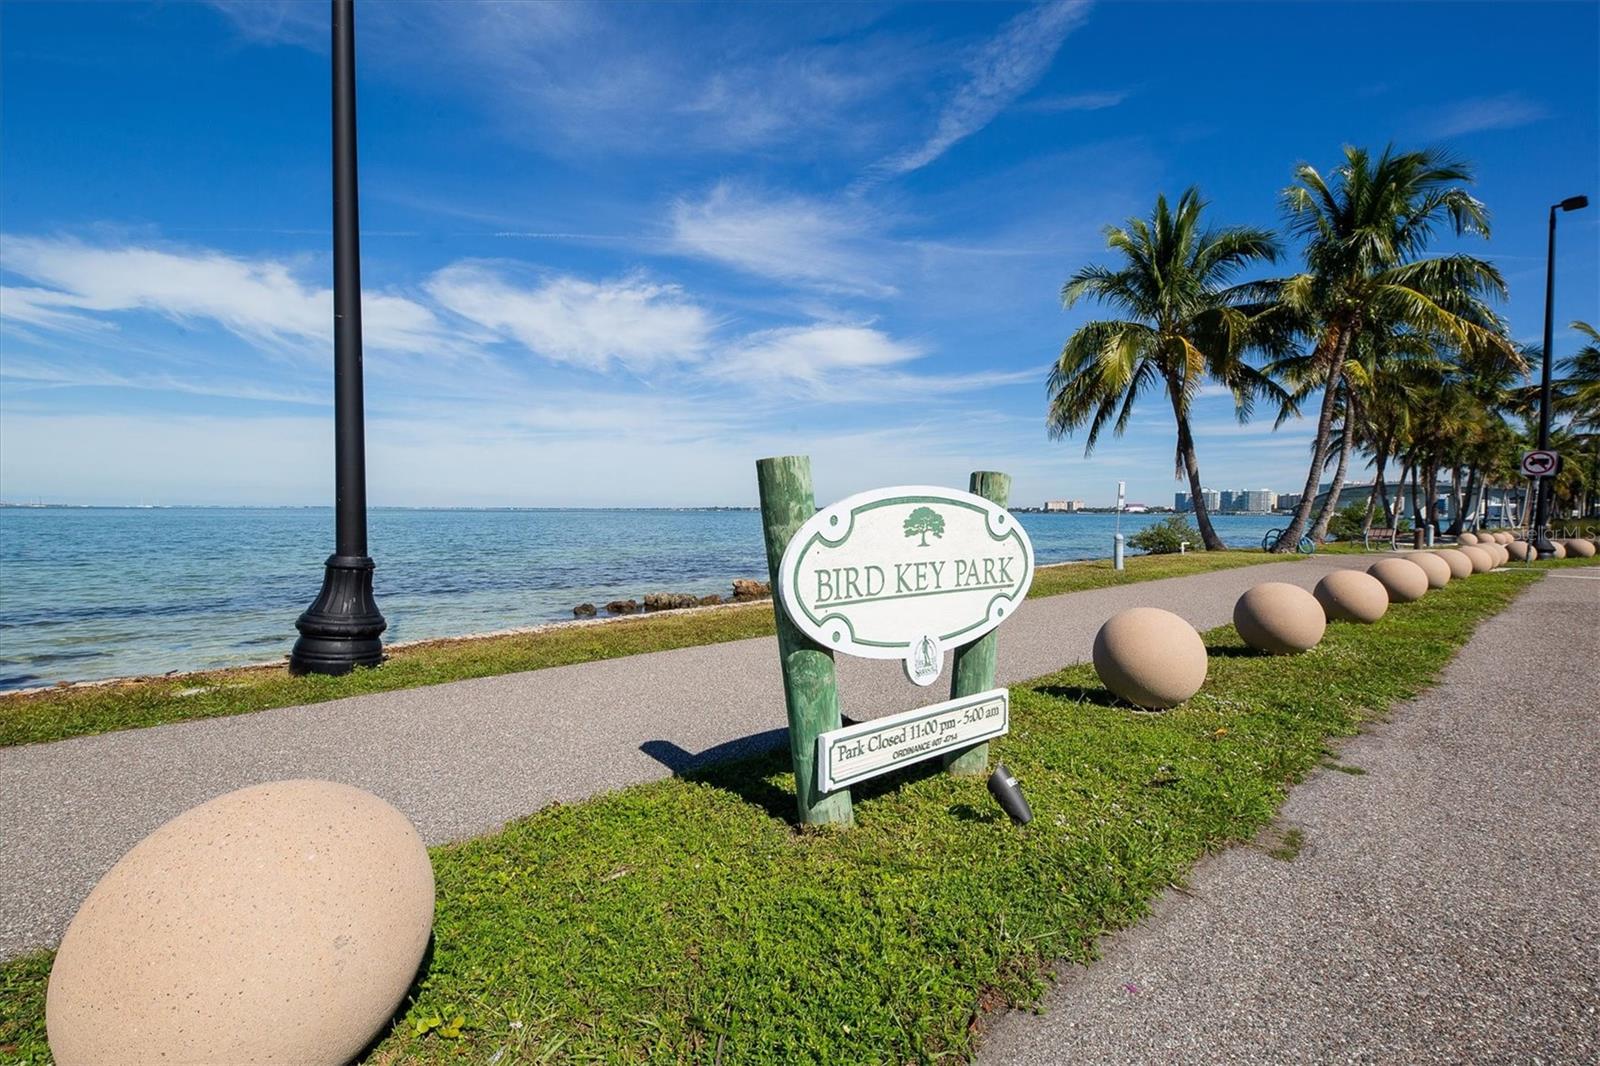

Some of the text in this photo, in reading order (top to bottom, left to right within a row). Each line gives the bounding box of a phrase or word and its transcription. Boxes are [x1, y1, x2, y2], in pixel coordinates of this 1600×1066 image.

[814, 556, 1014, 602] BIRD KEY PARK
[837, 740, 865, 762] Park
[867, 726, 906, 752] Closed
[910, 719, 938, 740] 11:00
[940, 719, 956, 736] pm
[963, 706, 984, 725] 5:00
[985, 706, 1000, 719] am
[892, 740, 931, 760] ORDINANCE
